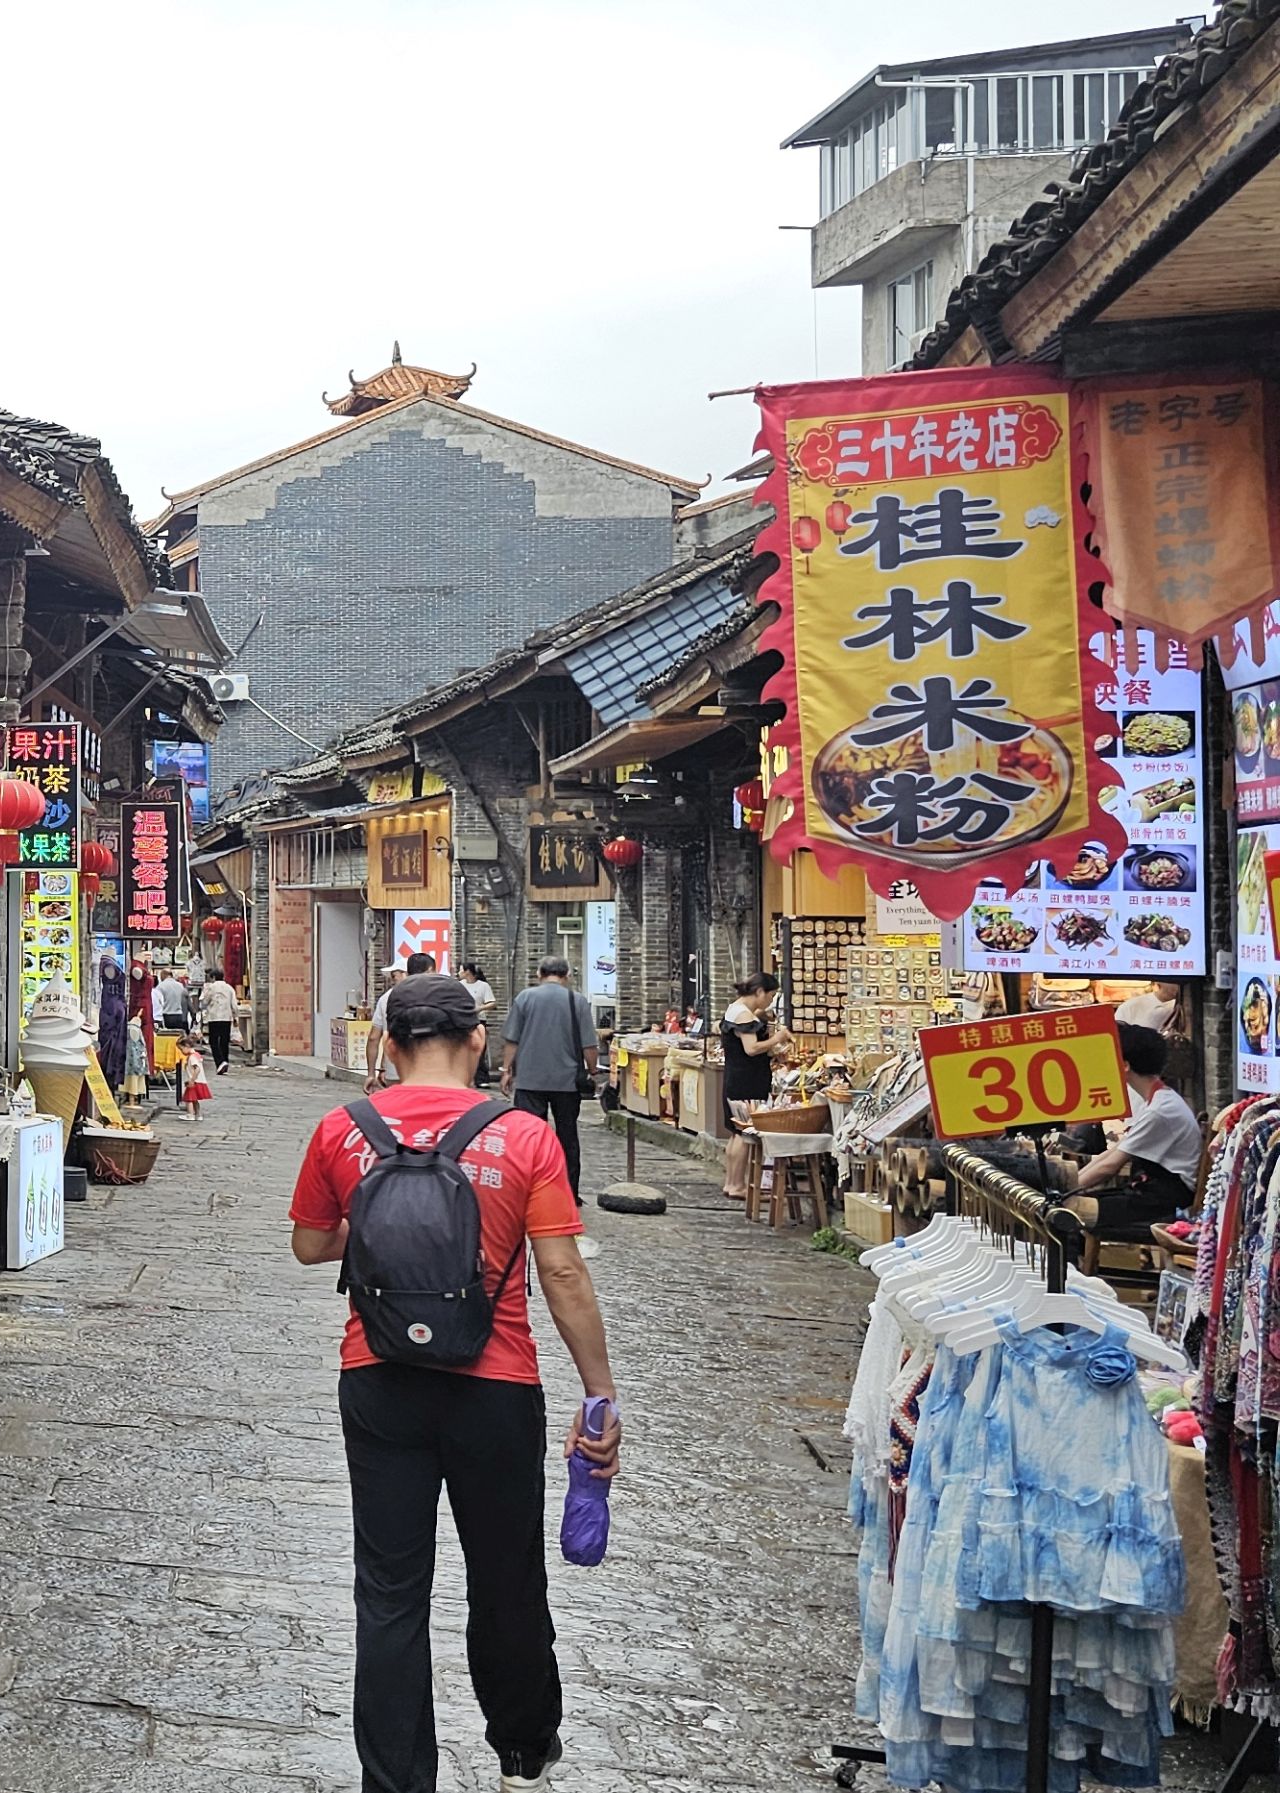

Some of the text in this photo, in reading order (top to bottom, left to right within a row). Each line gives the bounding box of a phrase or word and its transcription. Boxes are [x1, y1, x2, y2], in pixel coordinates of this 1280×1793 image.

[1109, 393, 1250, 435] 老字号
[836, 407, 1018, 478] 三十年老店
[840, 489, 1037, 846] 桂林米粉
[11, 729, 72, 761] 果汁
[132, 811, 168, 914] 温馨餐吧
[958, 1015, 1078, 1049] 特惠商品
